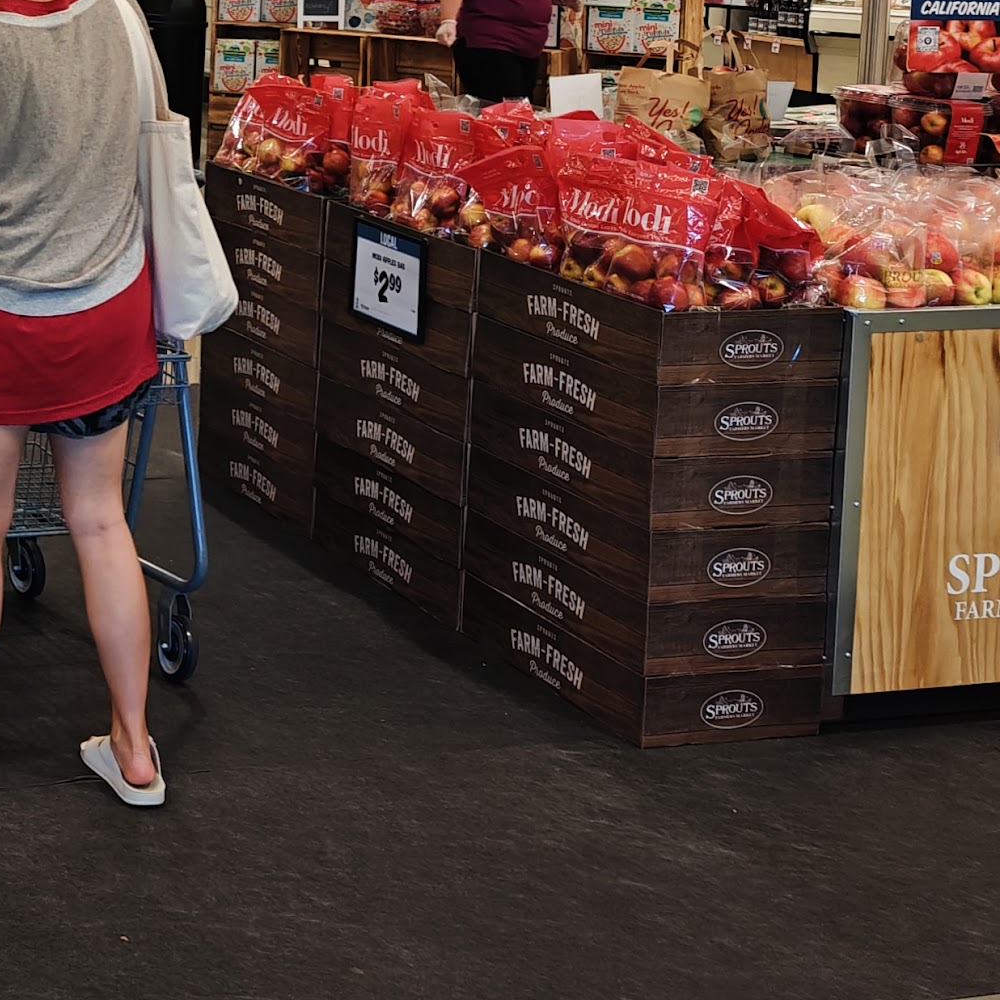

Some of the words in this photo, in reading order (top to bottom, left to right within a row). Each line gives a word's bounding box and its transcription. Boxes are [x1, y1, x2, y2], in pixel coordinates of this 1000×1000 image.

[920, 0, 1000, 16] CALIFORNIA
[649, 97, 690, 126] Yes!
[236, 194, 284, 226] FARM-FRESH
[380, 231, 398, 249] LOCAL
[234, 248, 282, 281] FARM-FRESH
[526, 294, 600, 341] FARM-FRESH
[545, 321, 578, 345] Produce
[724, 342, 778, 359] SPROUTS
[233, 356, 281, 394] FARM-FRESH
[360, 359, 420, 403] FARM-FRESH
[522, 362, 596, 412] FARM-FRESH
[375, 383, 403, 406] Produce
[541, 390, 574, 415] Produce
[231, 408, 279, 448] FARM-FRESH
[719, 414, 773, 431] SPROUTS
[356, 419, 416, 465] FARM-FRESH
[369, 443, 396, 468] Produce
[518, 427, 592, 479] FARM-FRESH
[229, 460, 277, 502] FARM-FRESH
[538, 455, 570, 482] Produce
[354, 476, 413, 524] FARM-FRESH
[713, 487, 767, 505] SPROUTS
[368, 502, 395, 526] Produce
[516, 495, 589, 551] FARM-FRESH
[535, 524, 568, 552] Produce
[354, 534, 413, 584] FARM-FRESH
[368, 560, 394, 585] Produce
[712, 560, 765, 578] SPROUTS
[511, 561, 586, 620] FARM-FRESH
[531, 591, 564, 620] Produce
[708, 631, 760, 649] SPROUTS
[510, 628, 584, 690] FARM-FRESH
[529, 659, 561, 690] Produce
[705, 701, 758, 720] SPROUTS
